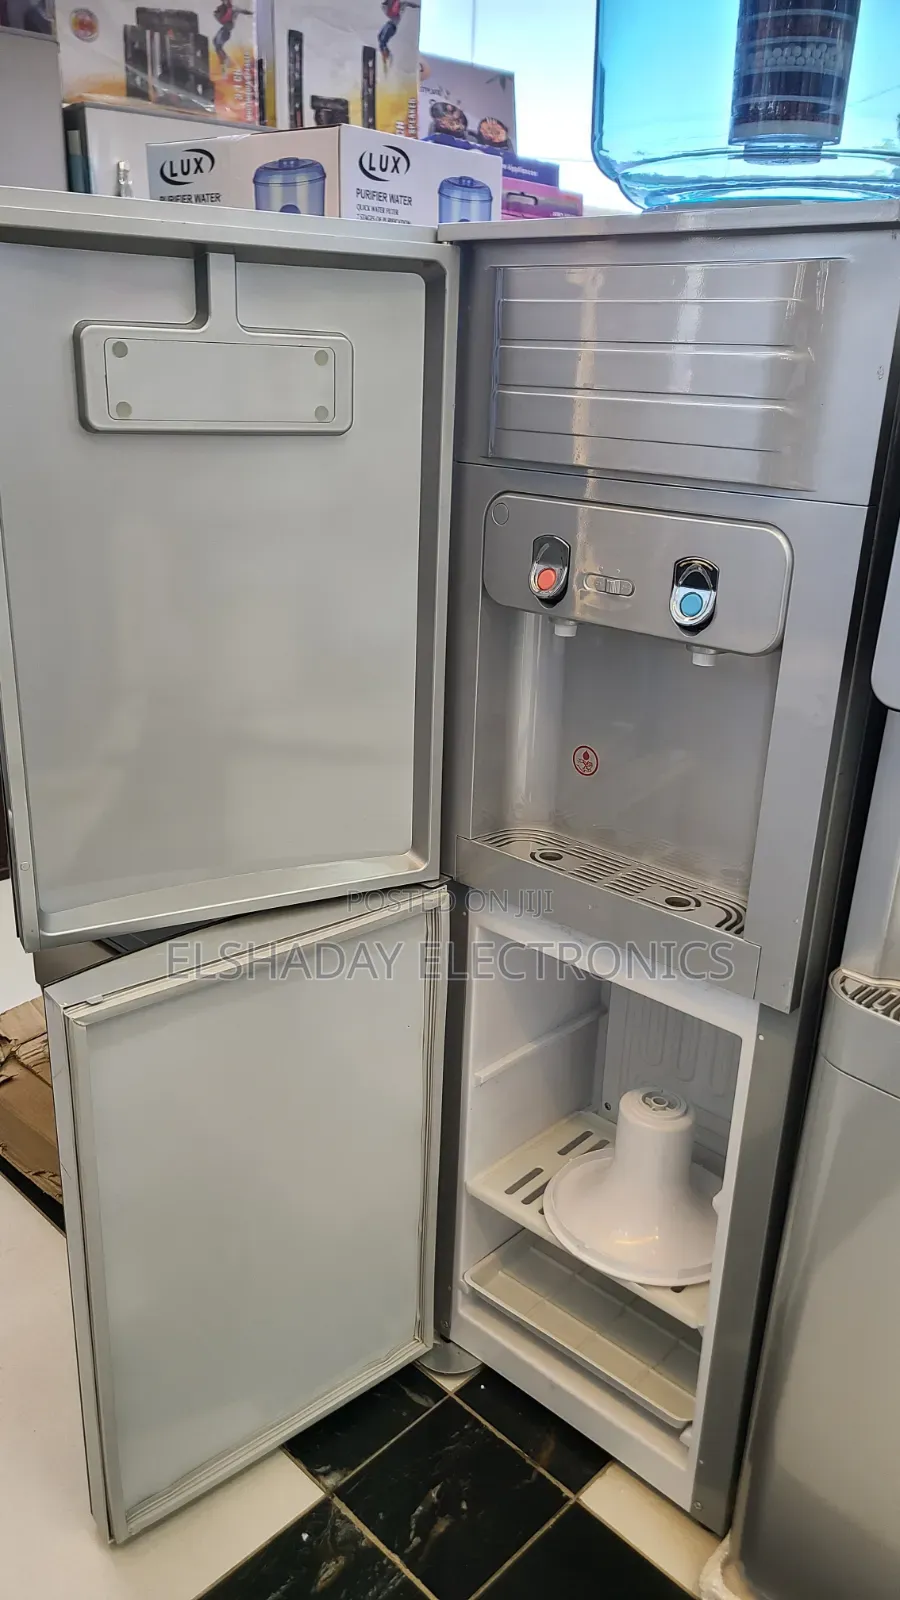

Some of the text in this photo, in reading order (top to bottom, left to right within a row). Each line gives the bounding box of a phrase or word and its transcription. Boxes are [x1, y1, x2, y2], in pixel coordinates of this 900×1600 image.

[407, 98, 417, 134] SPEAKER
[169, 157, 204, 177] LUX
[368, 152, 401, 174] LUX
[194, 192, 221, 203] WATER
[356, 187, 413, 206] PURIFIER WATER
[371, 205, 385, 214] WATER
